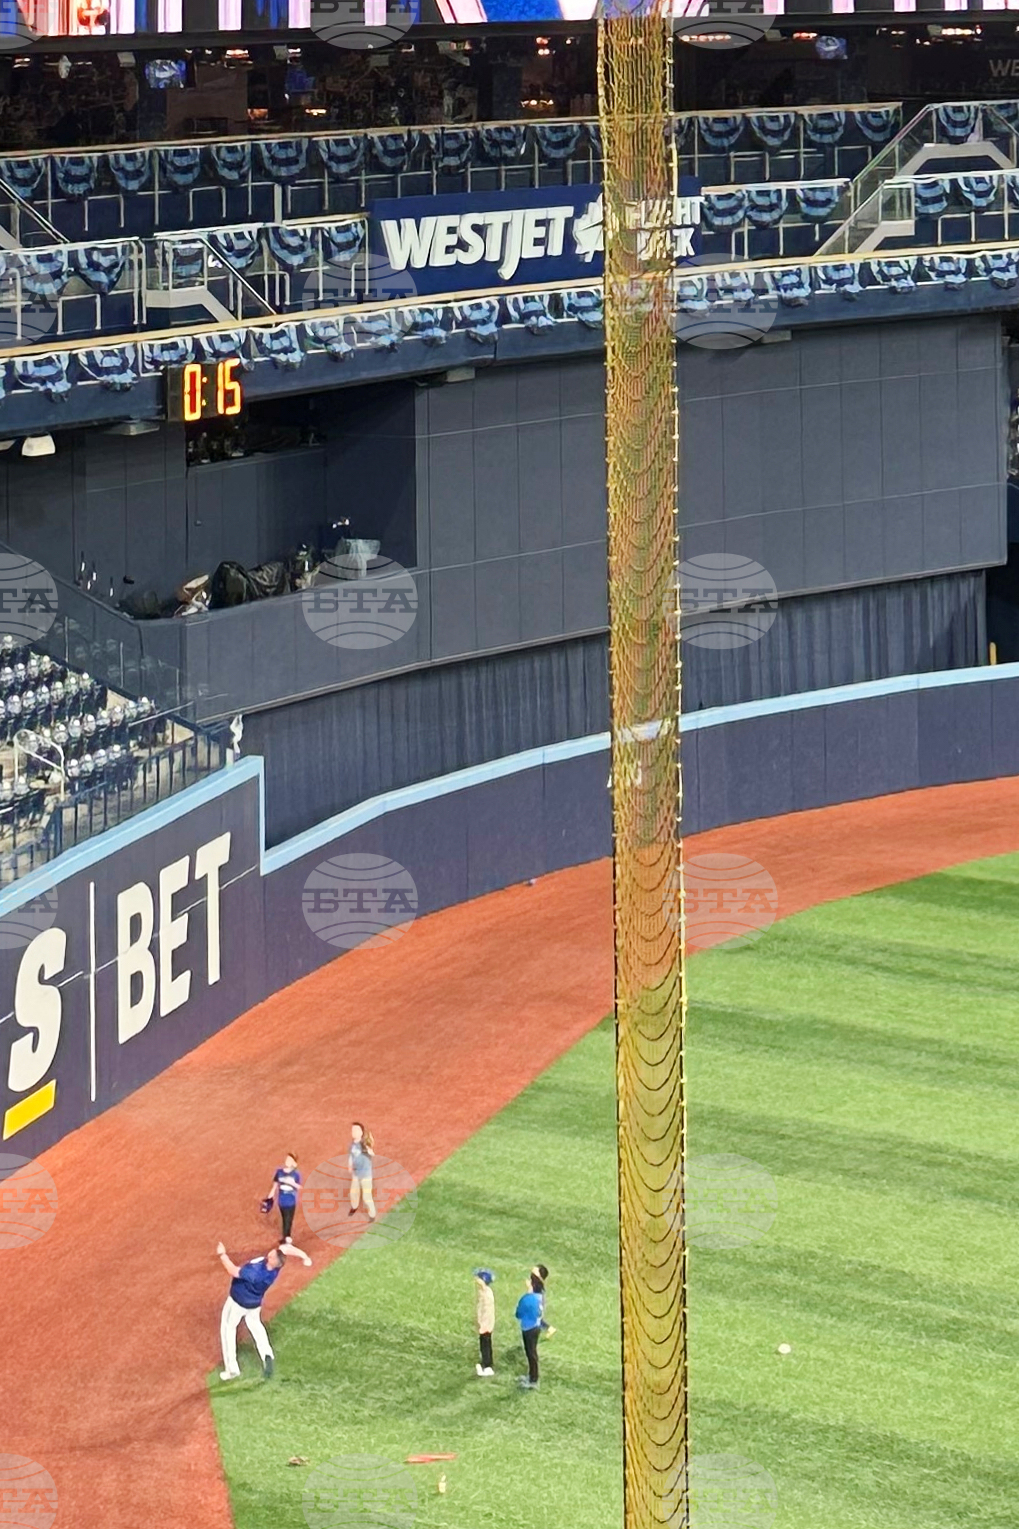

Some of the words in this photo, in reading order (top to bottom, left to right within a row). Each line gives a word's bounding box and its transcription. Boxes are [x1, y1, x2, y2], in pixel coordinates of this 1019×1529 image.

[381, 205, 573, 280] WESTJET
[184, 358, 241, 421] 0:15
[7, 927, 67, 1093] S
[117, 831, 231, 1045] BET
